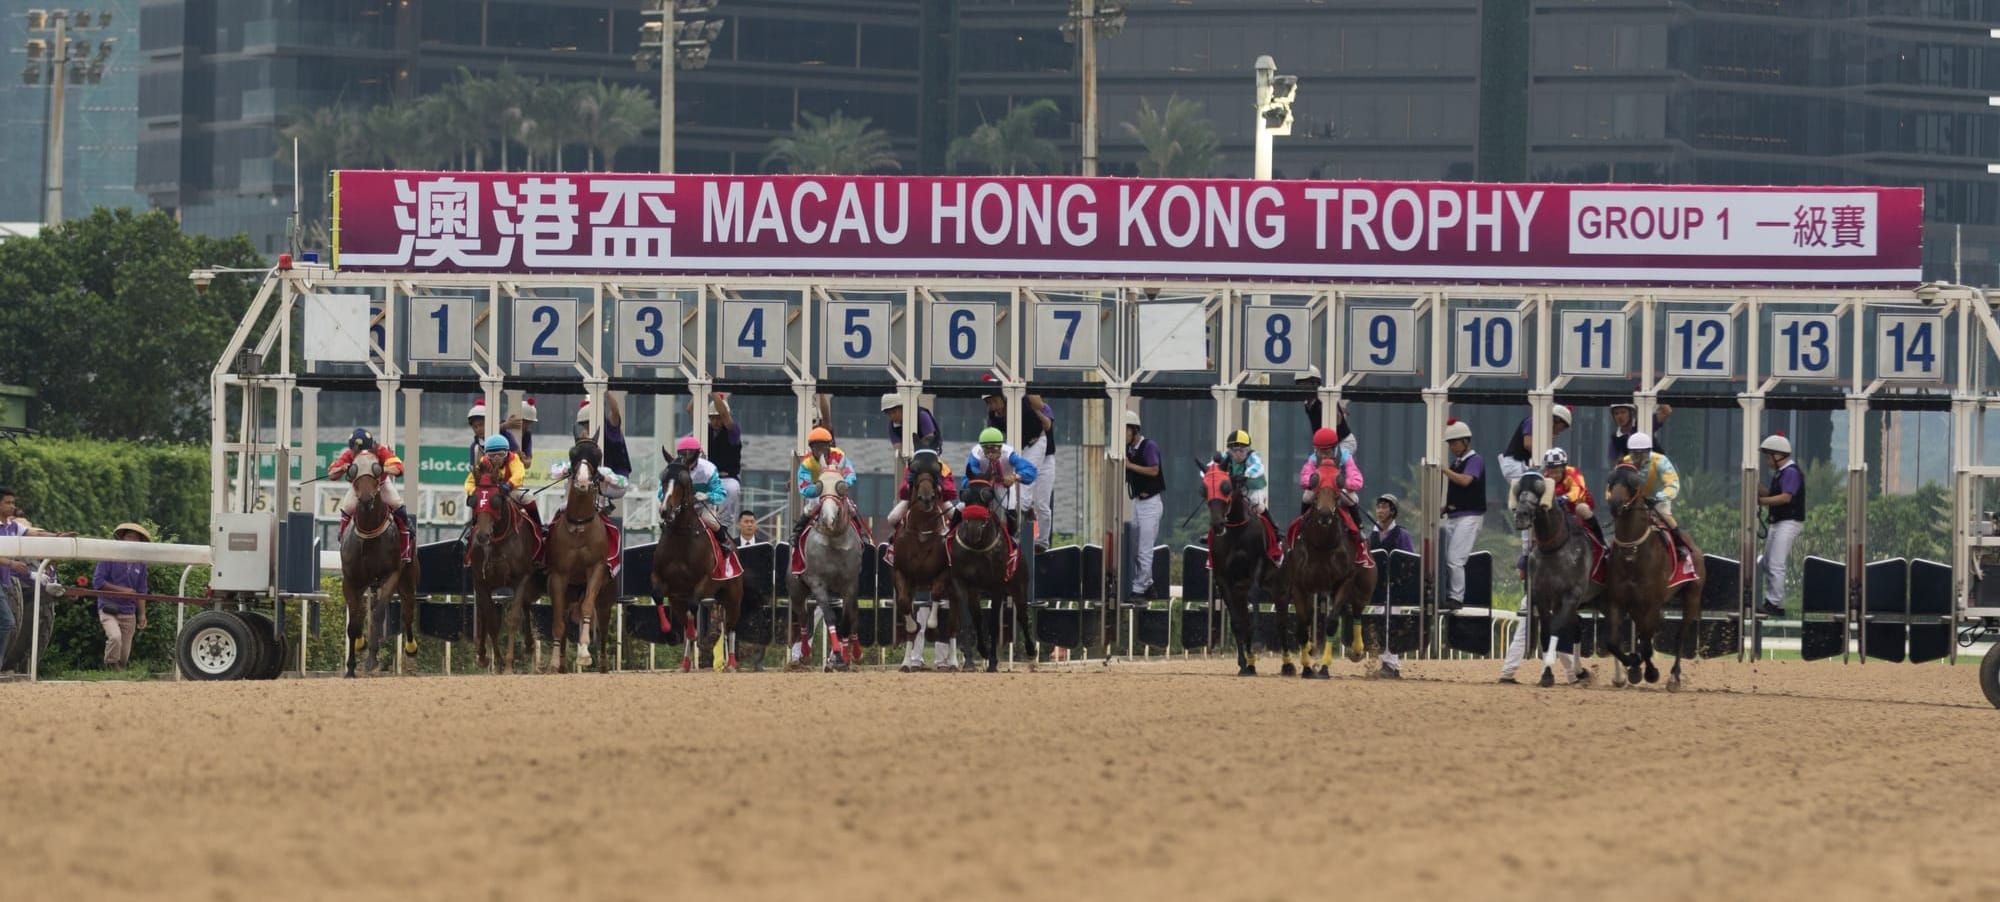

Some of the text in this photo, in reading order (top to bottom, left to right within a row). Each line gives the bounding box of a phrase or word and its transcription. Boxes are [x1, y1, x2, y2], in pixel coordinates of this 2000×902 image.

[393, 177, 677, 267] 澳港盃
[703, 181, 1544, 253] MACAU HONG KONG TROPHY
[1577, 205, 1730, 241] GROUP 1
[1755, 204, 1867, 249] 一級賽
[431, 304, 449, 354] 1
[531, 306, 560, 356] 2
[635, 307, 664, 357] 3
[737, 308, 767, 358] 4
[843, 309, 872, 359] 5
[948, 310, 977, 360] 6
[1053, 311, 1082, 360] 7
[1264, 314, 1292, 364] 8
[1368, 315, 1397, 366] 9
[1463, 317, 1513, 368] 10
[1573, 319, 1612, 369] 11
[1674, 320, 1725, 370] 12
[1781, 321, 1830, 372] 13
[1887, 322, 1936, 372] 14
[440, 500, 456, 516] 10
